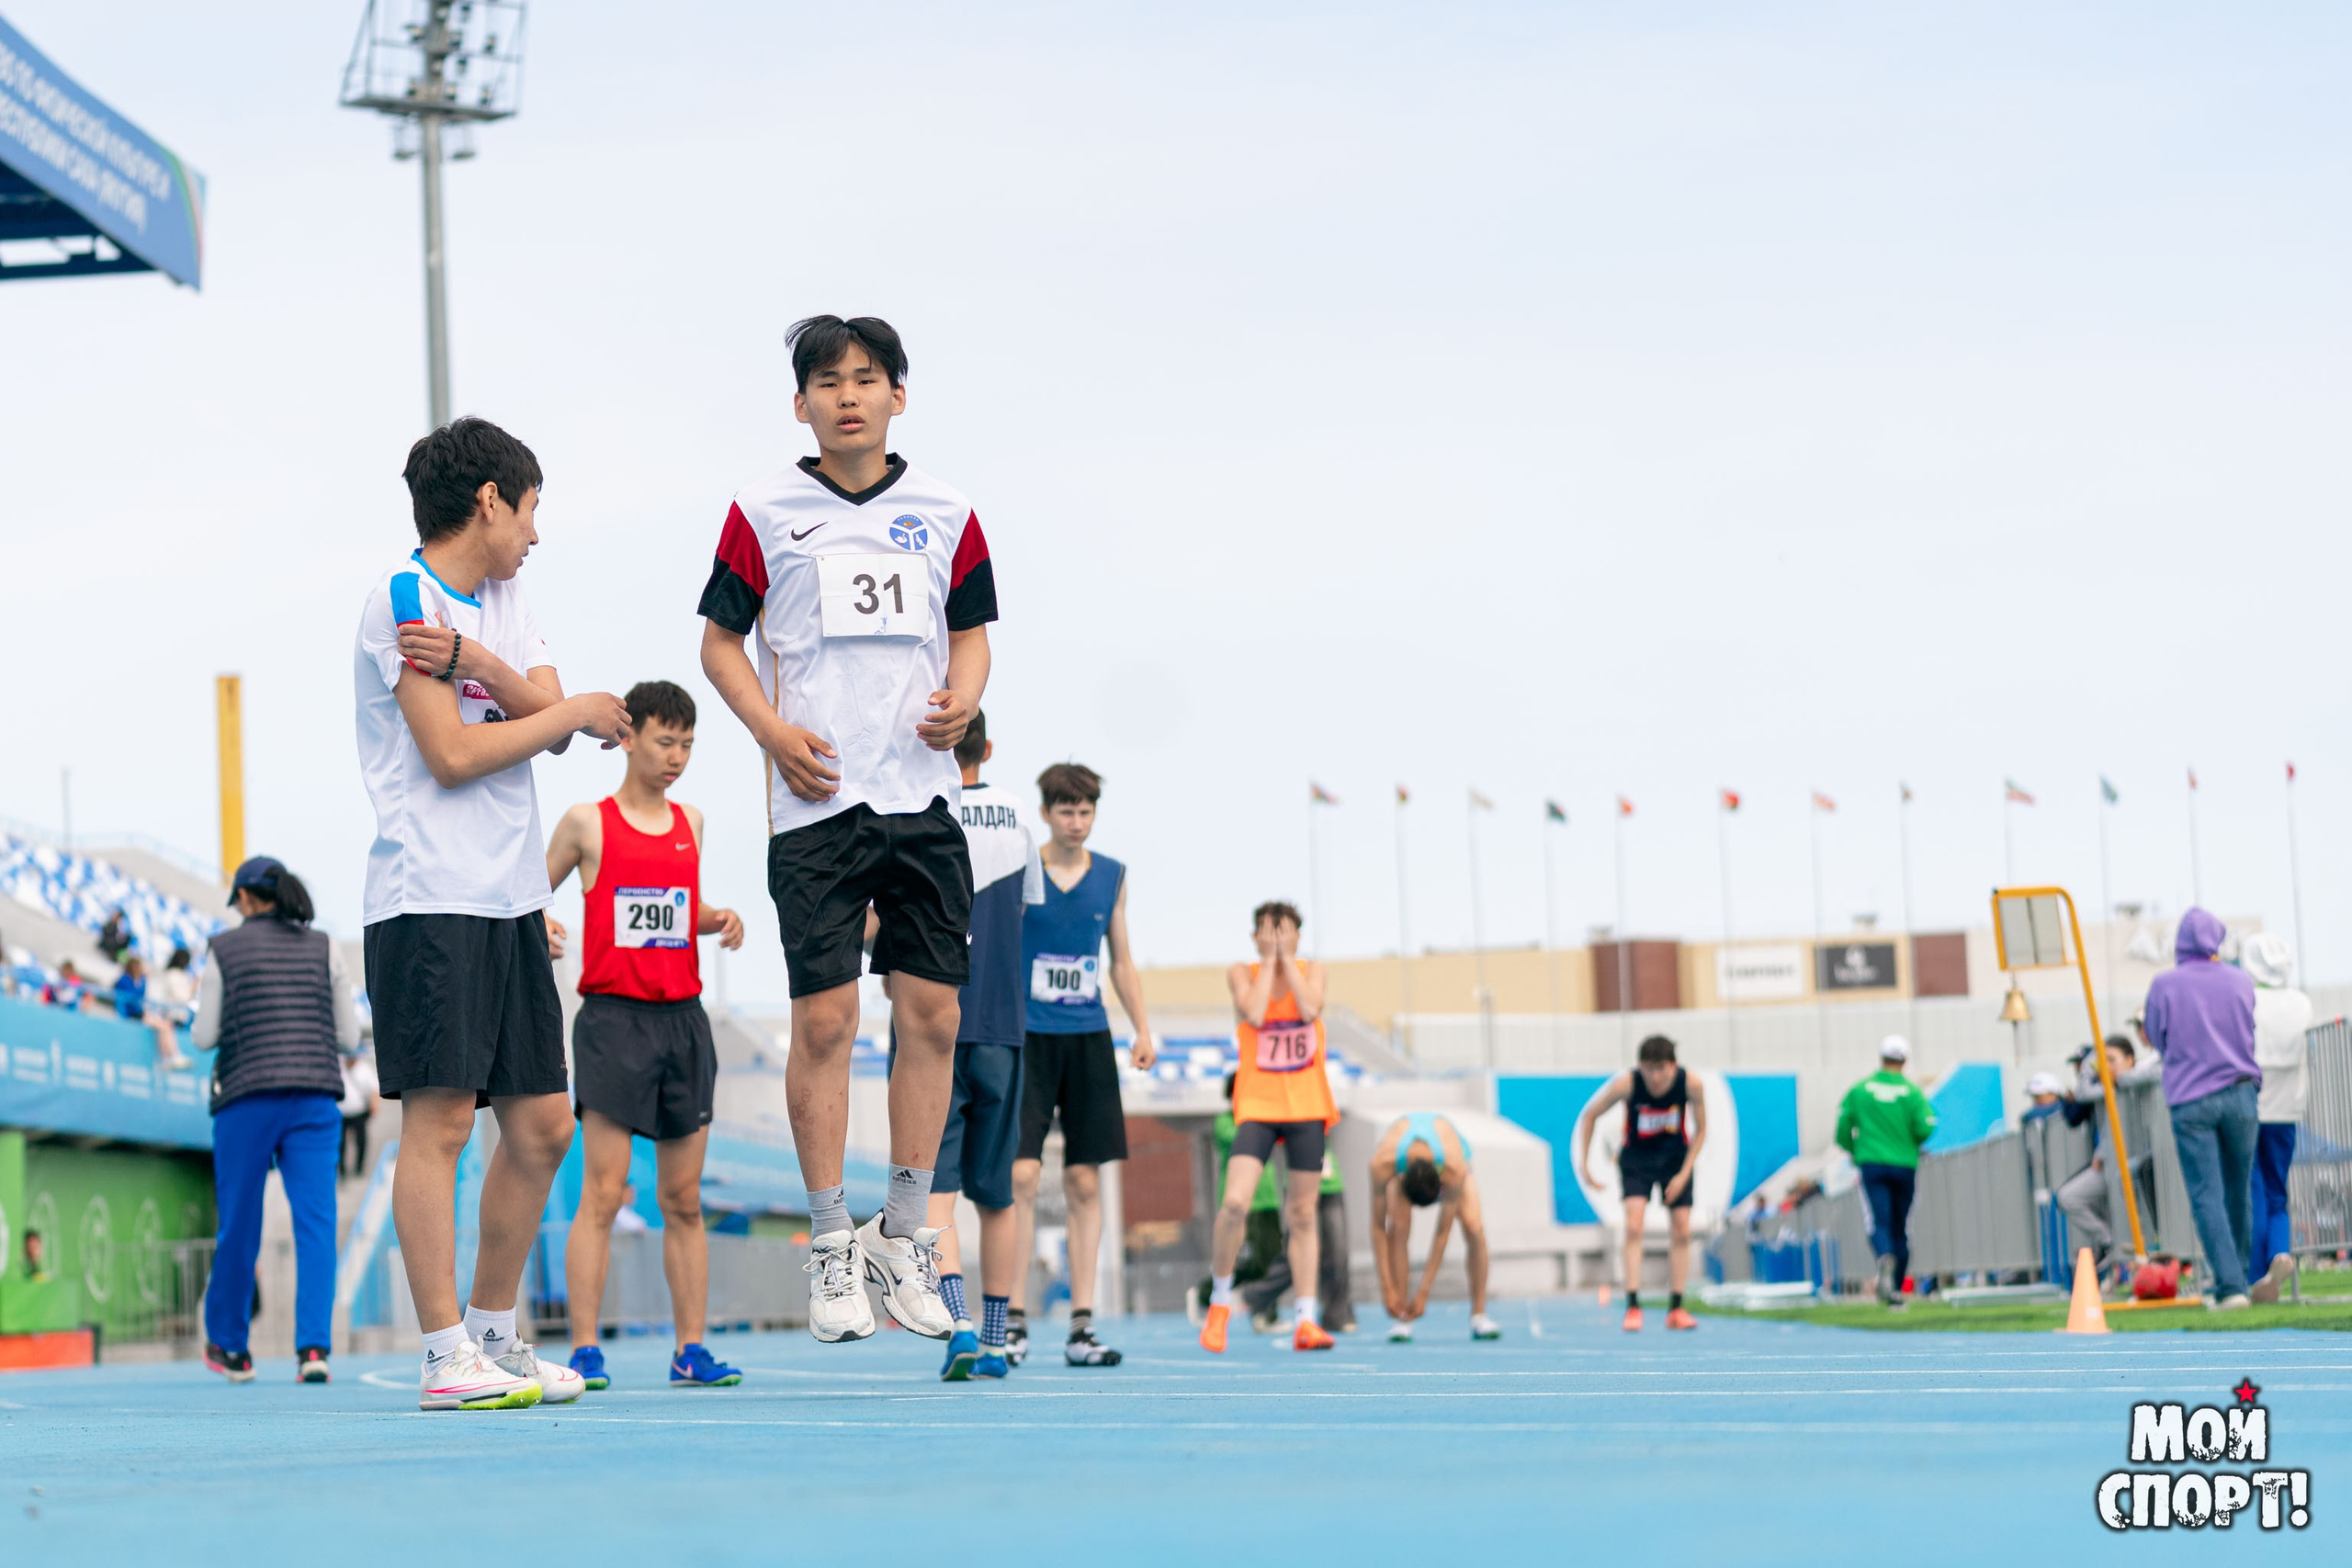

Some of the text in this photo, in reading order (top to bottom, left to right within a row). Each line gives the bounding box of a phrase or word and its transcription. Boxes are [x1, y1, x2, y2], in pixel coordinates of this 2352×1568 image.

[853, 573, 904, 615] 31
[961, 806, 1016, 829] АЛДАН
[628, 904, 673, 931] 290
[1046, 968, 1080, 991] 100
[1267, 1034, 1306, 1061] 716
